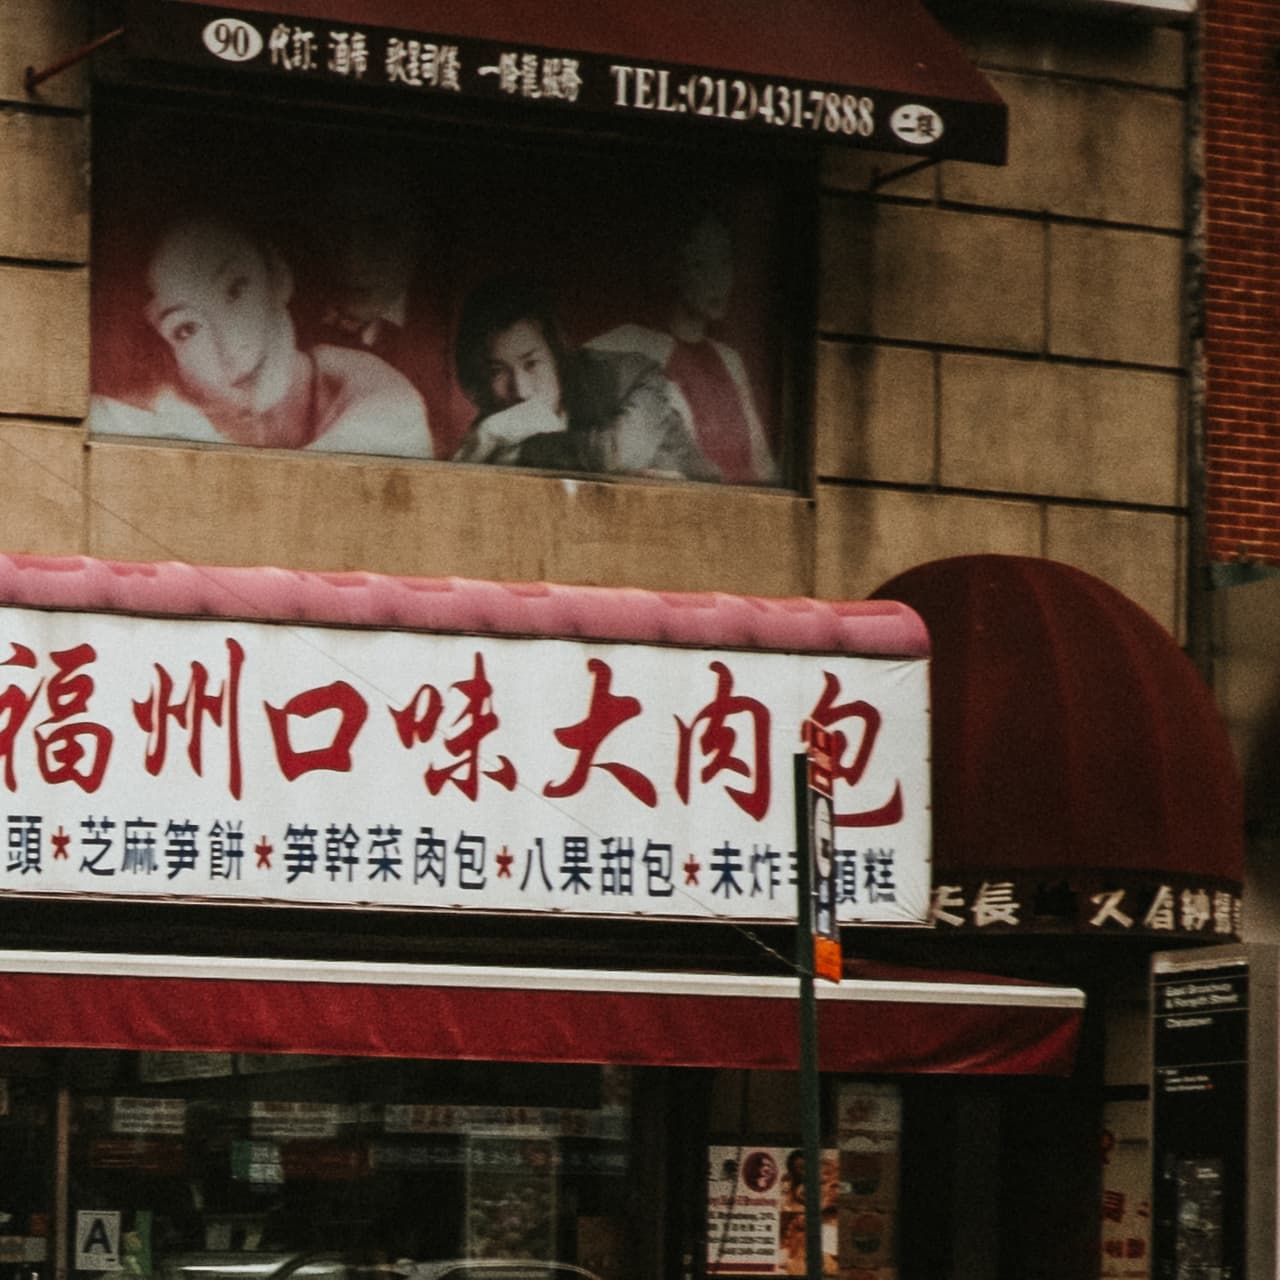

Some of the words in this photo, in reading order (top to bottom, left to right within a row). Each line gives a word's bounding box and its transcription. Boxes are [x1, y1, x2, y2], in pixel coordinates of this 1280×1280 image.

[214, 23, 249, 56] 90
[520, 835, 675, 898] 八果甜包
[83, 1218, 113, 1254] A
